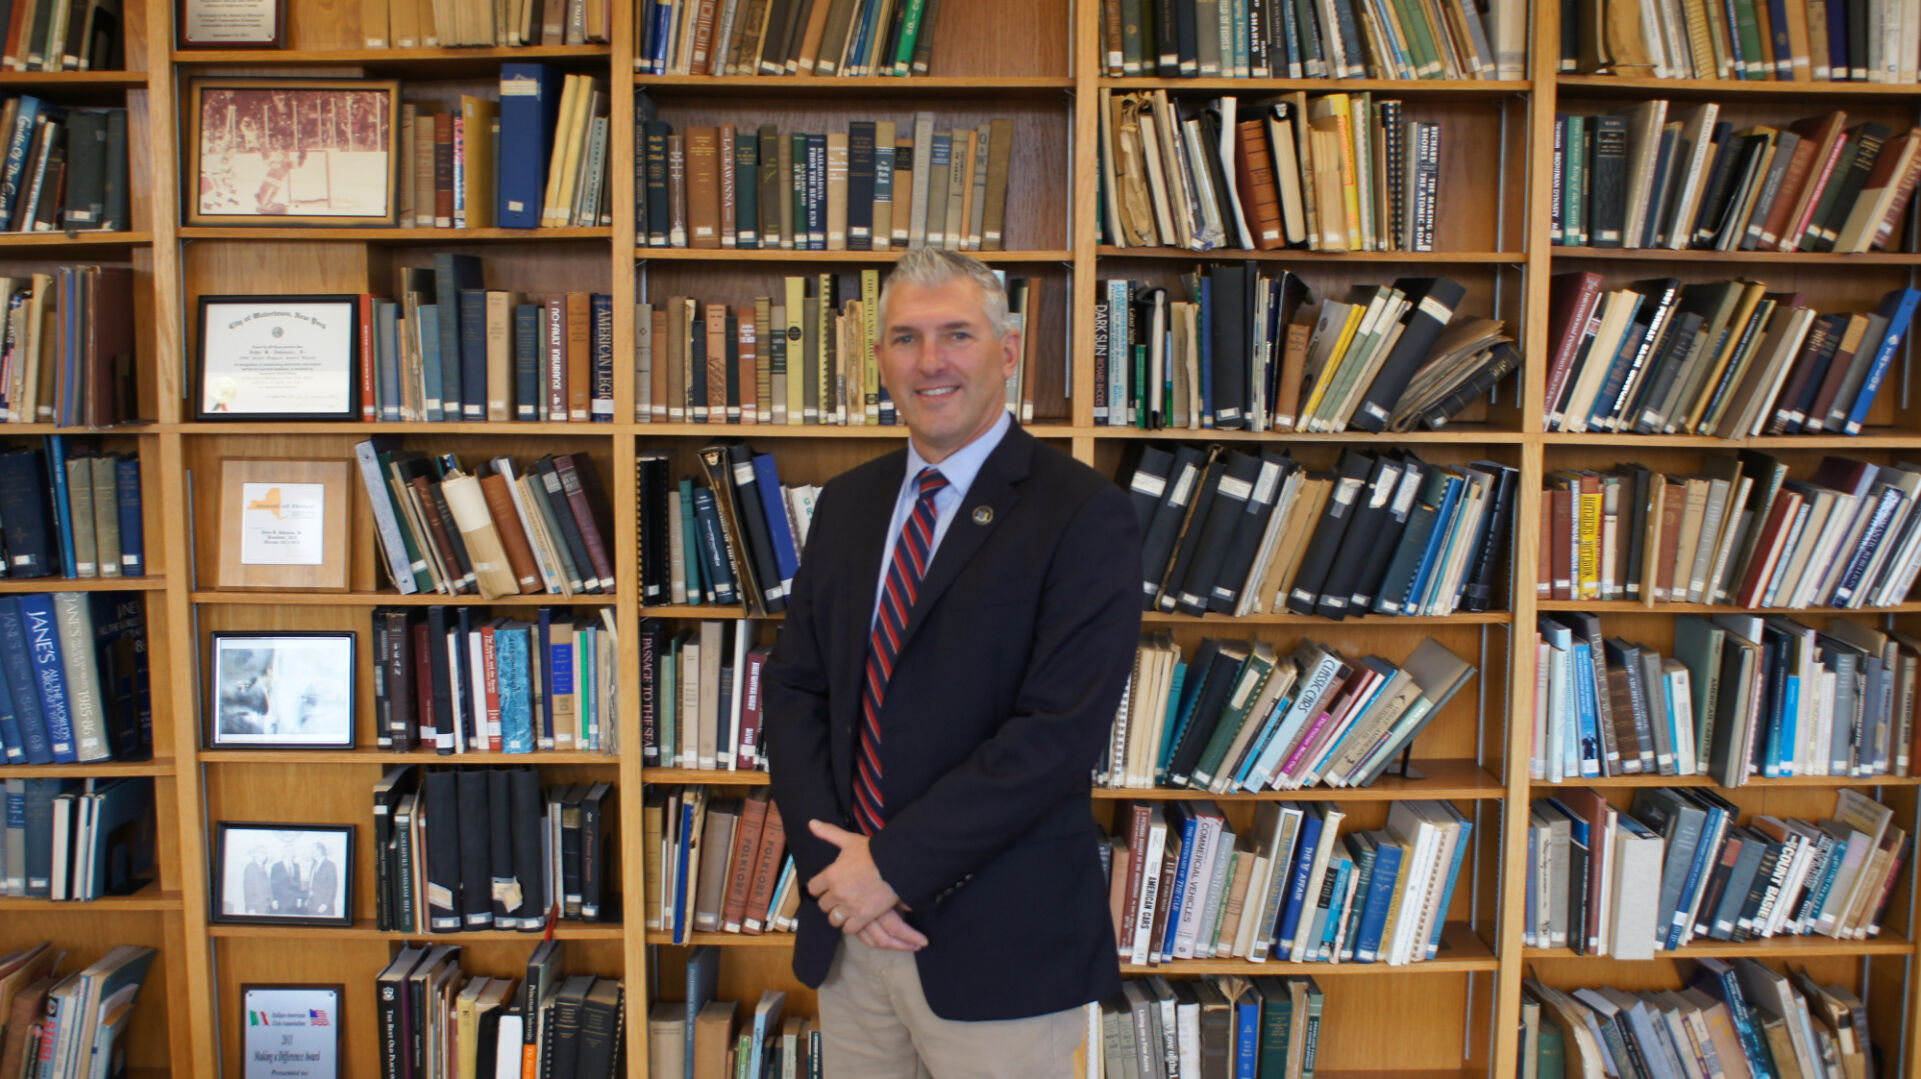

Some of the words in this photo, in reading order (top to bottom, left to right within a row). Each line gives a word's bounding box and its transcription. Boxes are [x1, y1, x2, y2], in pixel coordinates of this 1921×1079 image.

[1236, 22, 1245, 52] Fisheries
[1250, 12, 1259, 52] SHARKS
[1420, 127, 1428, 160] RHODES
[1428, 126, 1437, 162] RICHARD
[1554, 121, 1562, 148] Newman
[5, 160, 22, 182] The
[723, 138, 732, 207] LACKAWANNA
[794, 164, 801, 174] AT
[808, 147, 816, 168] FROM
[1552, 151, 1561, 188] BRONFMAN
[1419, 173, 1427, 188] THE
[1427, 177, 1435, 194] THE
[1417, 190, 1426, 223] ATOMIC
[1426, 196, 1434, 228] MAKING
[1551, 189, 1559, 217] DYNASTY
[1415, 226, 1424, 250] BOM
[1425, 233, 1433, 243] OF
[549, 307, 561, 345] NO-FAULT
[1096, 304, 1108, 334] DARK
[1569, 291, 1591, 335] International
[596, 308, 612, 366] AMERICAN
[1096, 336, 1108, 356] SUN
[1556, 334, 1575, 371] Petroleum
[550, 348, 563, 390] INSURANCE
[1848, 549, 1872, 590] REBELLION
[26, 608, 56, 665] JANE'S
[1591, 632, 1605, 666] PLAN
[47, 667, 58, 683] ALL
[62, 597, 83, 638] JANE'S
[76, 690, 97, 735] 1985-86
[642, 637, 652, 683] PASSAGE
[1310, 658, 1337, 692] CLASSIC
[749, 675, 758, 694] WATER
[1596, 668, 1607, 683] OF
[50, 683, 62, 699] THE
[642, 686, 652, 701] TO
[747, 695, 757, 710] WEST
[1297, 688, 1318, 714] CARS
[1705, 677, 1717, 720] AMERICAN
[642, 703, 652, 725] THE
[1599, 687, 1616, 746] CHICAGO
[642, 727, 652, 747] SEA
[1190, 821, 1209, 880] COMMERCIAL
[1301, 846, 1313, 861] THE
[733, 837, 752, 895] FOLKLORE
[753, 839, 775, 898] FOLKLORE
[1770, 845, 1795, 887] COUNT
[1143, 875, 1155, 909] AMERICAN
[1173, 879, 1184, 895] THE
[1292, 872, 1307, 900] AFFAIR
[1171, 895, 1181, 911] CAR
[1182, 881, 1198, 923] VEHICLES
[1759, 885, 1779, 919] BASIE
[1140, 912, 1150, 929] CARS
[1137, 1009, 1145, 1027] Living
[1142, 1055, 1150, 1072] Acres
[1163, 1031, 1176, 1050] Love
[1164, 1050, 1178, 1060] of
[255, 1050, 274, 1064] Making
[278, 1050, 304, 1064] Difference
[306, 1050, 320, 1061] Award
[1167, 1059, 1178, 1072] the
